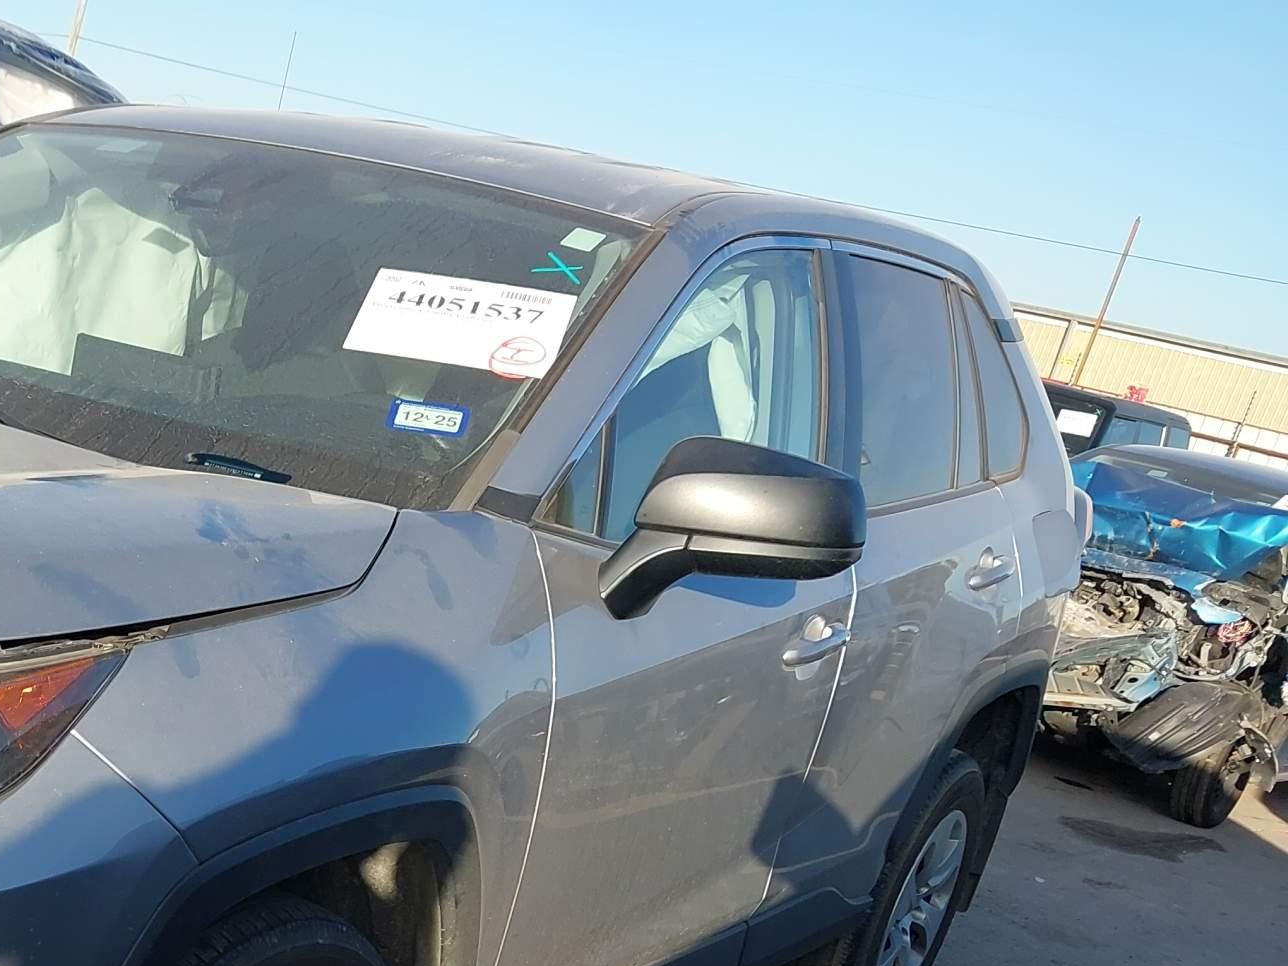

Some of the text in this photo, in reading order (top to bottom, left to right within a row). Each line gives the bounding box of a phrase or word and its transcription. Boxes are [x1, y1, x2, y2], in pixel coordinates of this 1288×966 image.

[388, 290, 544, 324] 44051537
[402, 410, 425, 423] 12
[433, 414, 459, 428] 25
